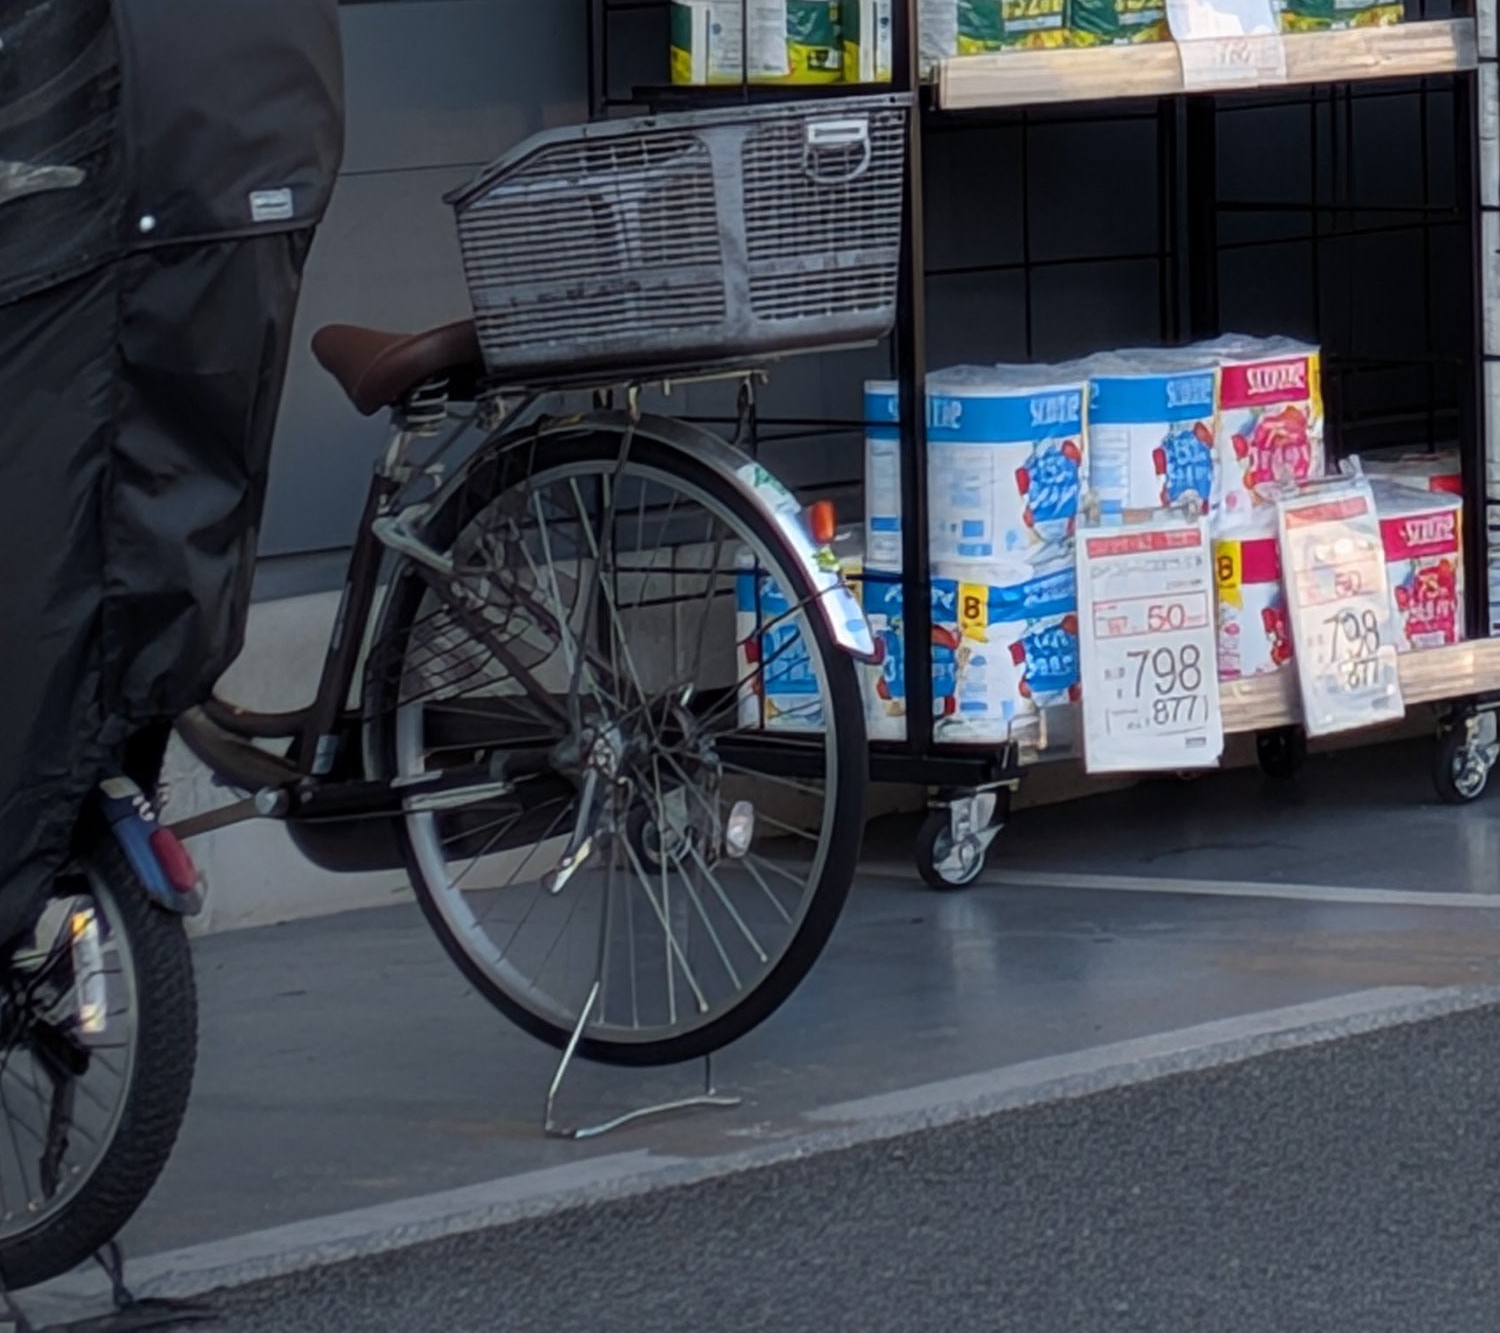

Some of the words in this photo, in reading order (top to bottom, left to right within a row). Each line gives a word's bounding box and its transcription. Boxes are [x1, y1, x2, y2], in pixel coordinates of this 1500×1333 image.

[1148, 603, 1185, 631] 50
[1126, 643, 1202, 699] 798
[1153, 694, 1198, 725] 877
